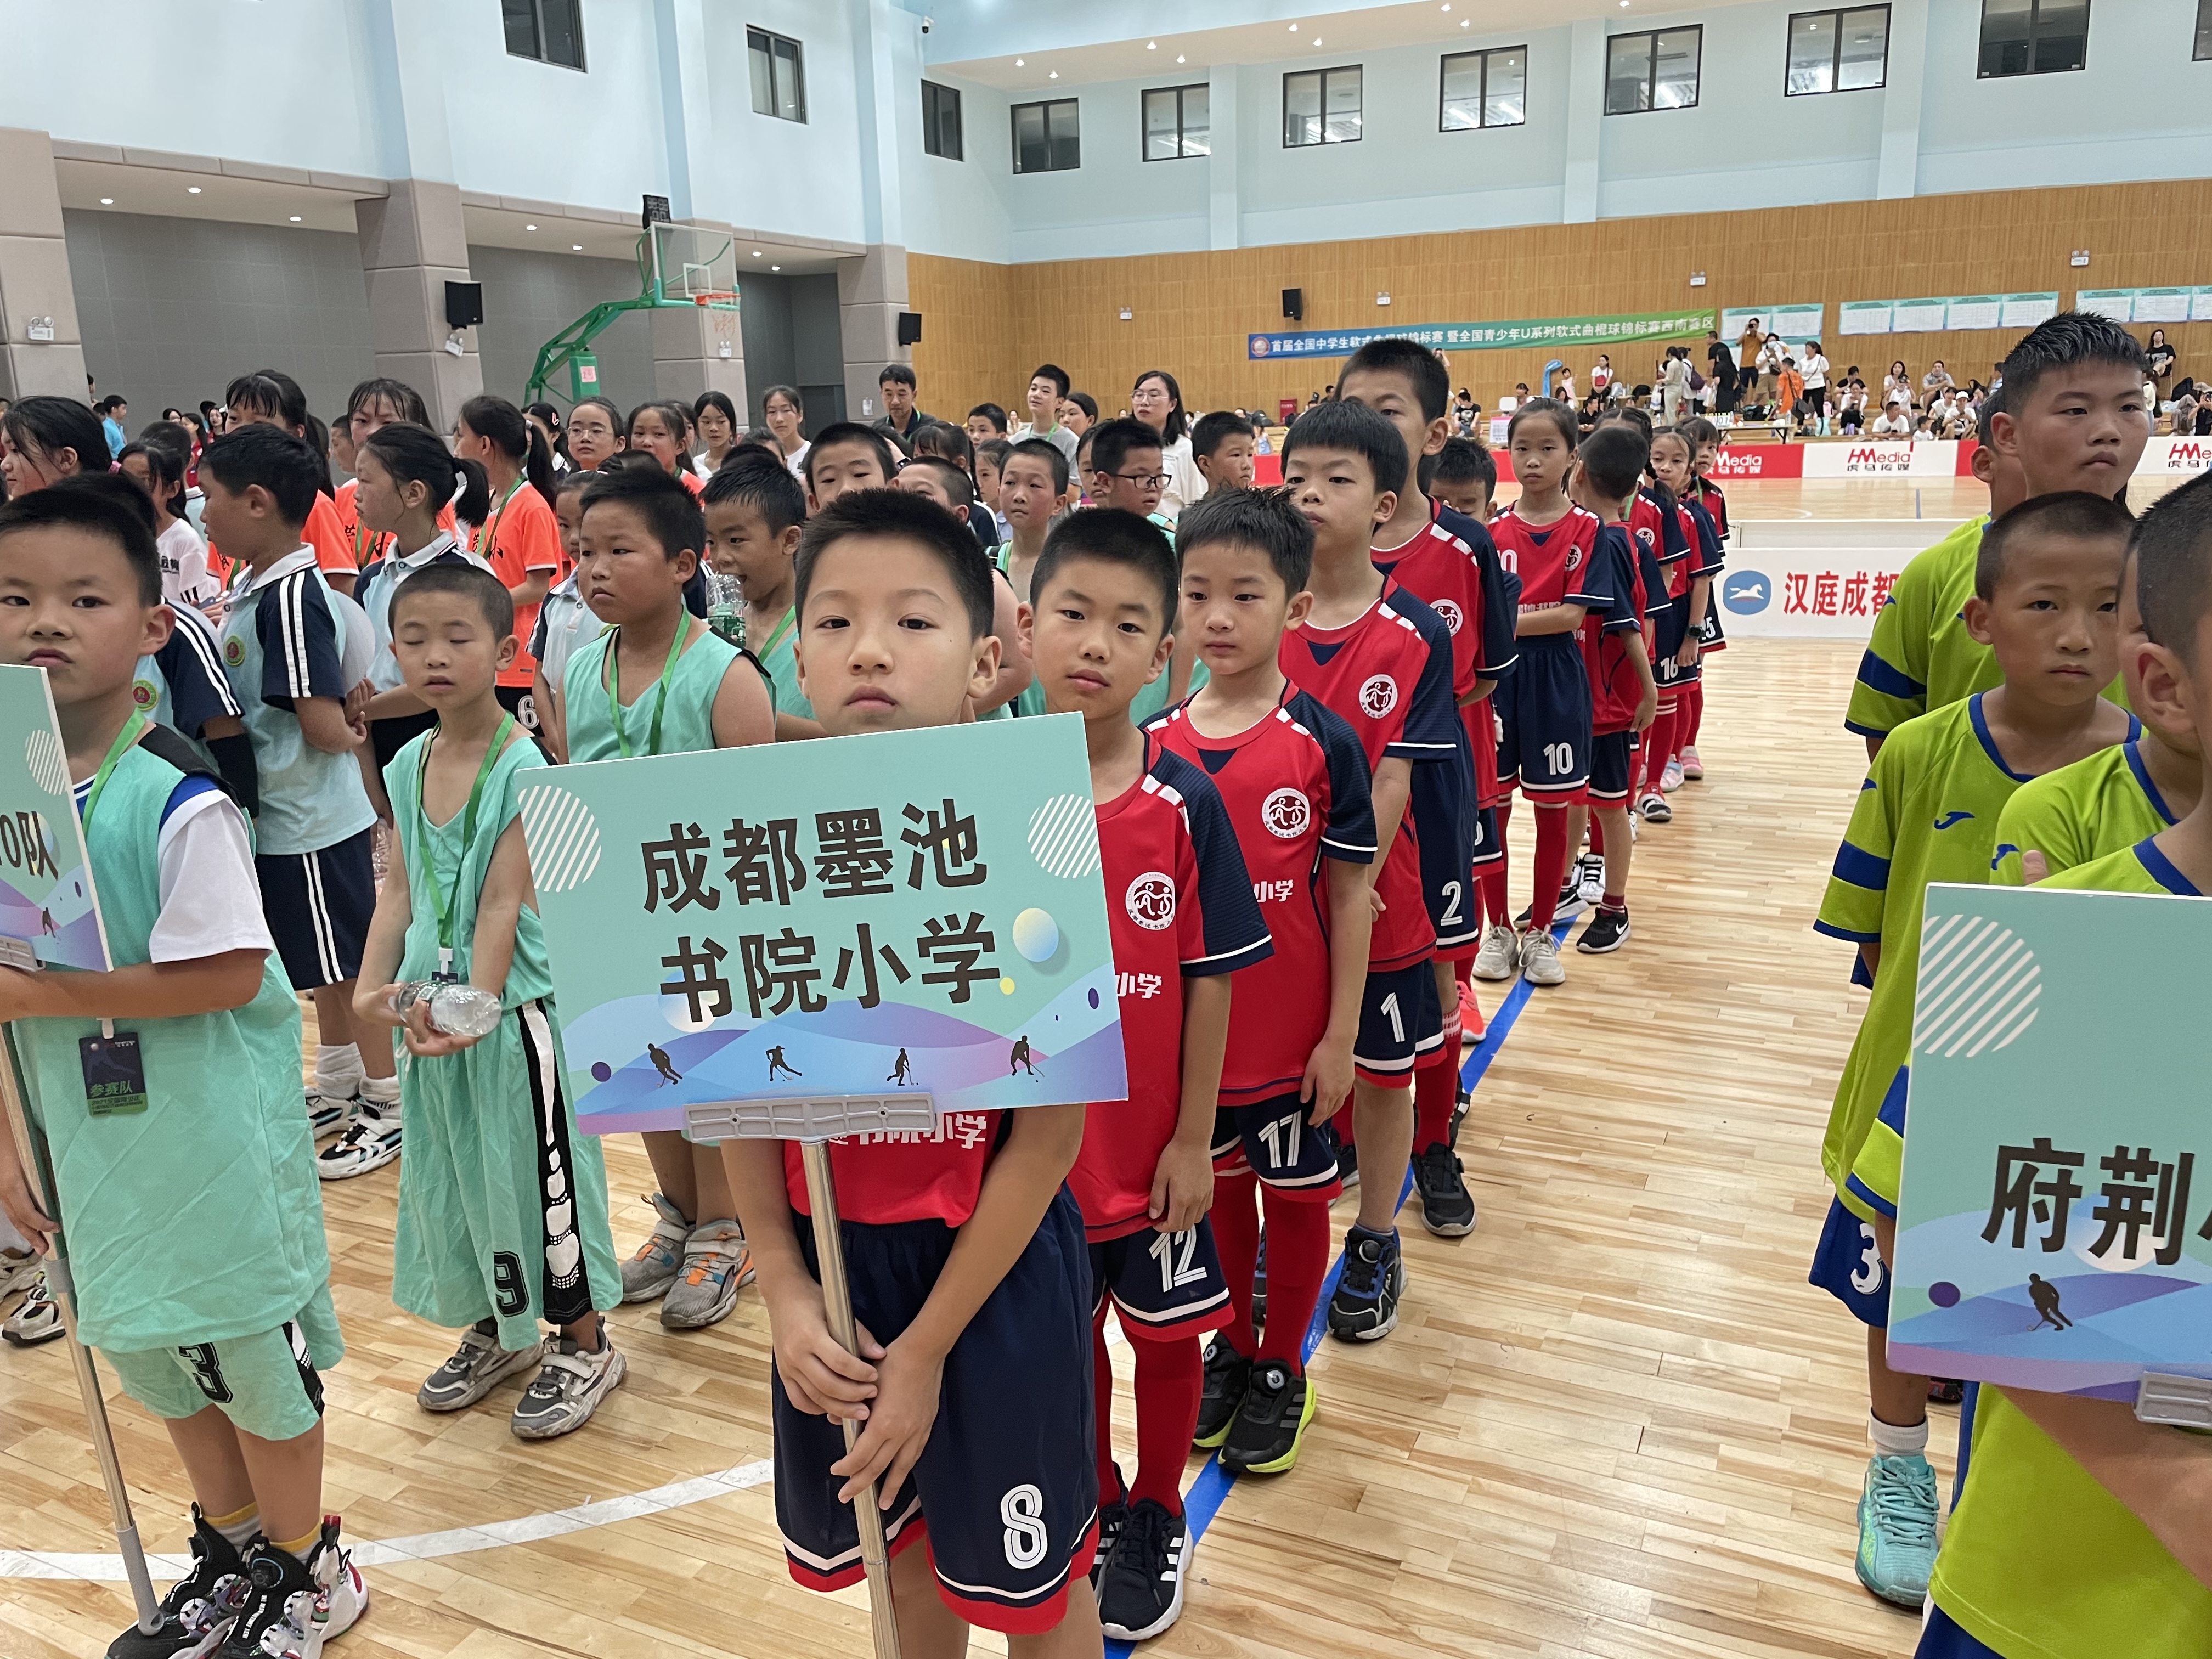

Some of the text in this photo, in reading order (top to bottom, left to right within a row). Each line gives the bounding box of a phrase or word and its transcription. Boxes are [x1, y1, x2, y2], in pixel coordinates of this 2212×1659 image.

[1716, 450, 1762, 466] Media
[1848, 448, 1910, 463] HMedia
[1660, 656, 1679, 680] 16
[518, 695, 539, 730] 6
[1543, 742, 1573, 775] 10
[0, 811, 59, 881] 0队
[641, 798, 988, 914] 成都墨池
[1254, 879, 1293, 902] 小学
[1441, 881, 1462, 926] 2
[659, 911, 1000, 1023] 书院小学
[1115, 972, 1162, 998] 小学
[1380, 992, 1406, 1043] 1
[91, 1080, 133, 1097] 参赛队
[1258, 1110, 1301, 1169] 17
[1980, 1138, 2212, 1265] 府荆
[493, 1251, 529, 1318] 9
[1149, 1223, 1207, 1293] 12
[1850, 1223, 1884, 1295] 3
[177, 1341, 234, 1404] 3
[1000, 1483, 1048, 1570] 8
